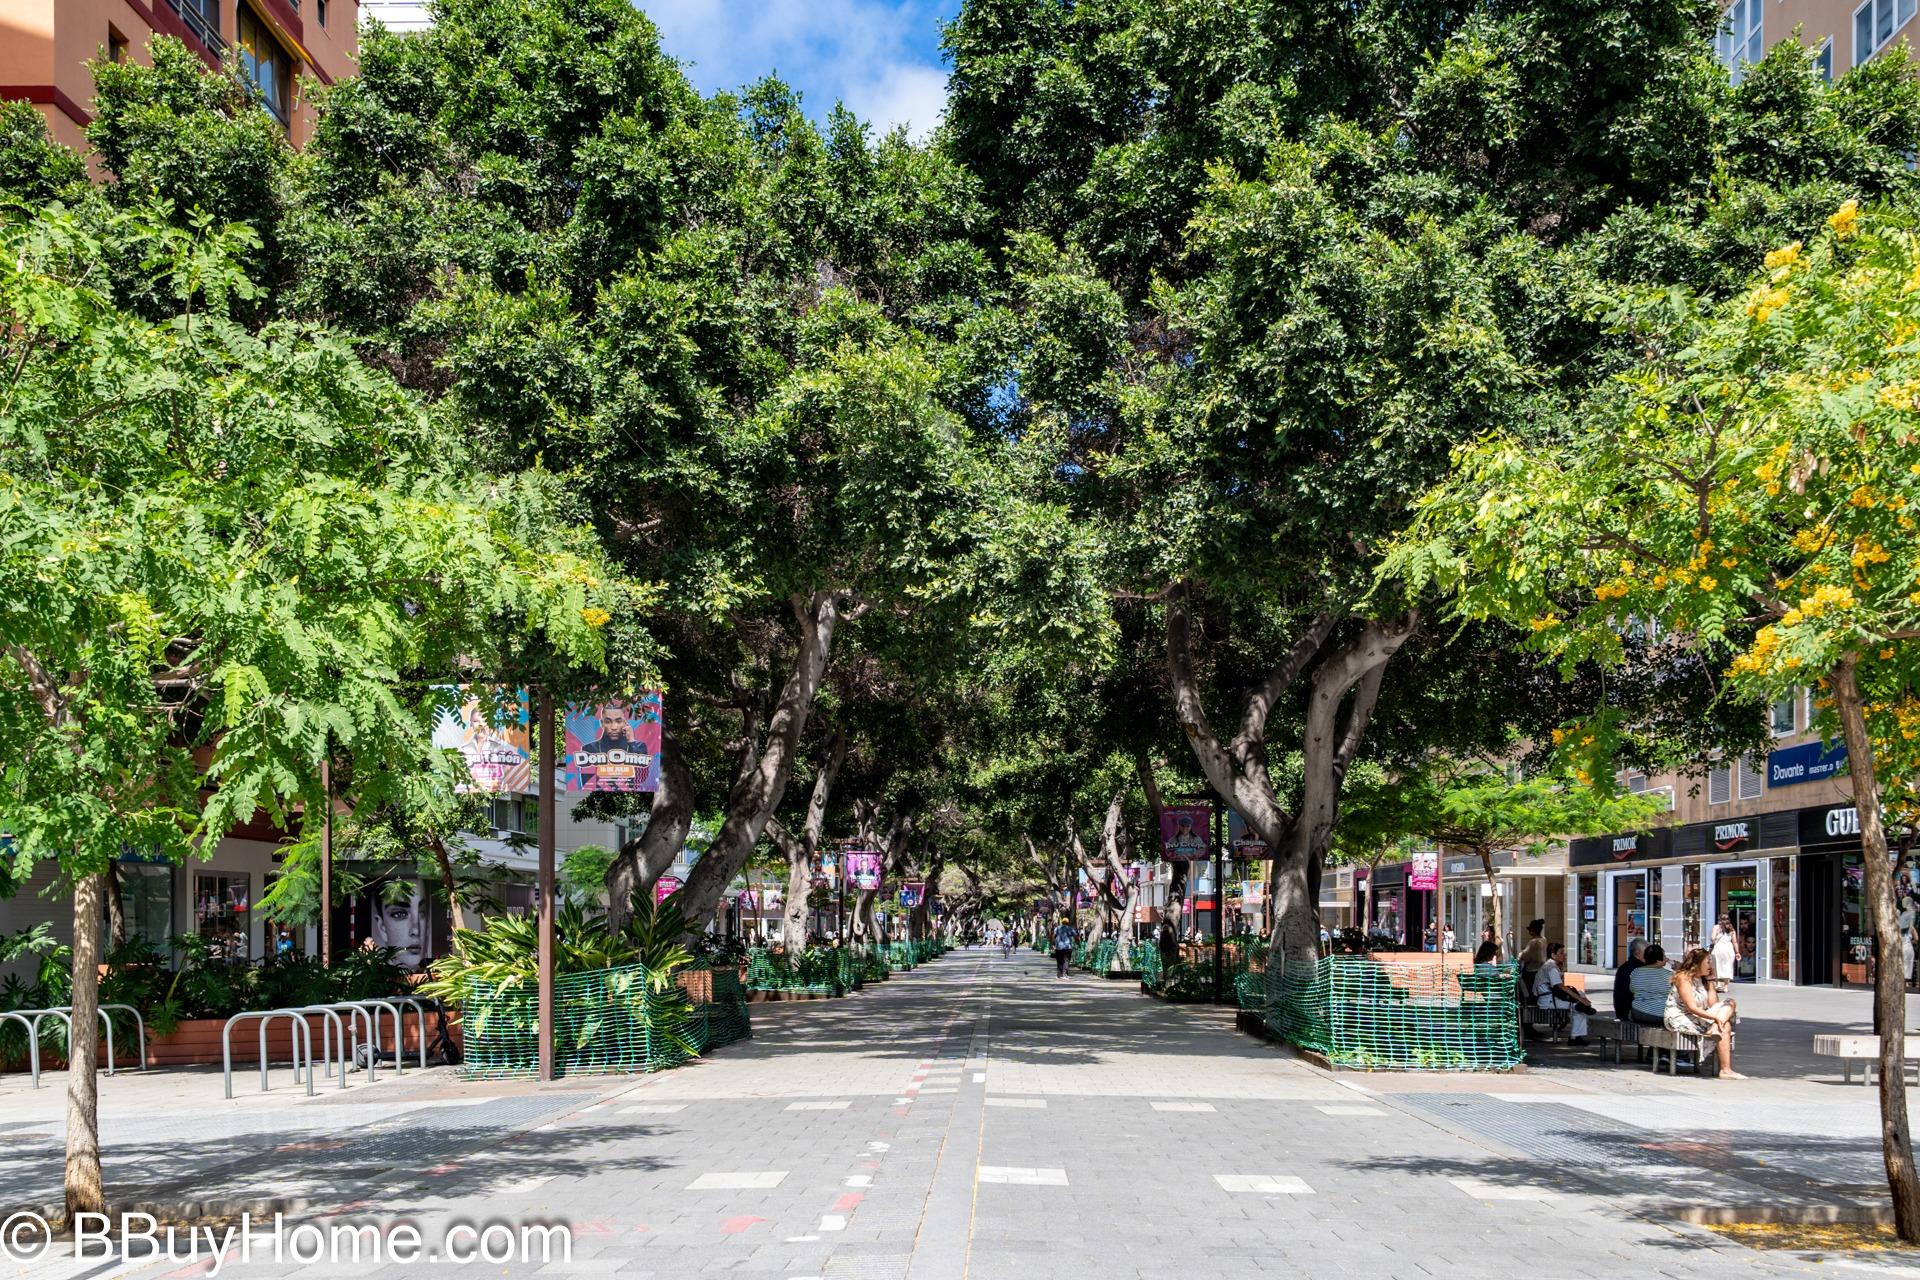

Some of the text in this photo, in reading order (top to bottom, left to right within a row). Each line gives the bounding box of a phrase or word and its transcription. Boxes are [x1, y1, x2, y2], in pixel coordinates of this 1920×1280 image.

[481, 750, 520, 764] Tañón
[575, 750, 652, 766] Don Omar
[1773, 763, 1804, 780] Davante
[1714, 822, 1750, 840] PRIMOR
[1612, 836, 1637, 851] PRIMOR
